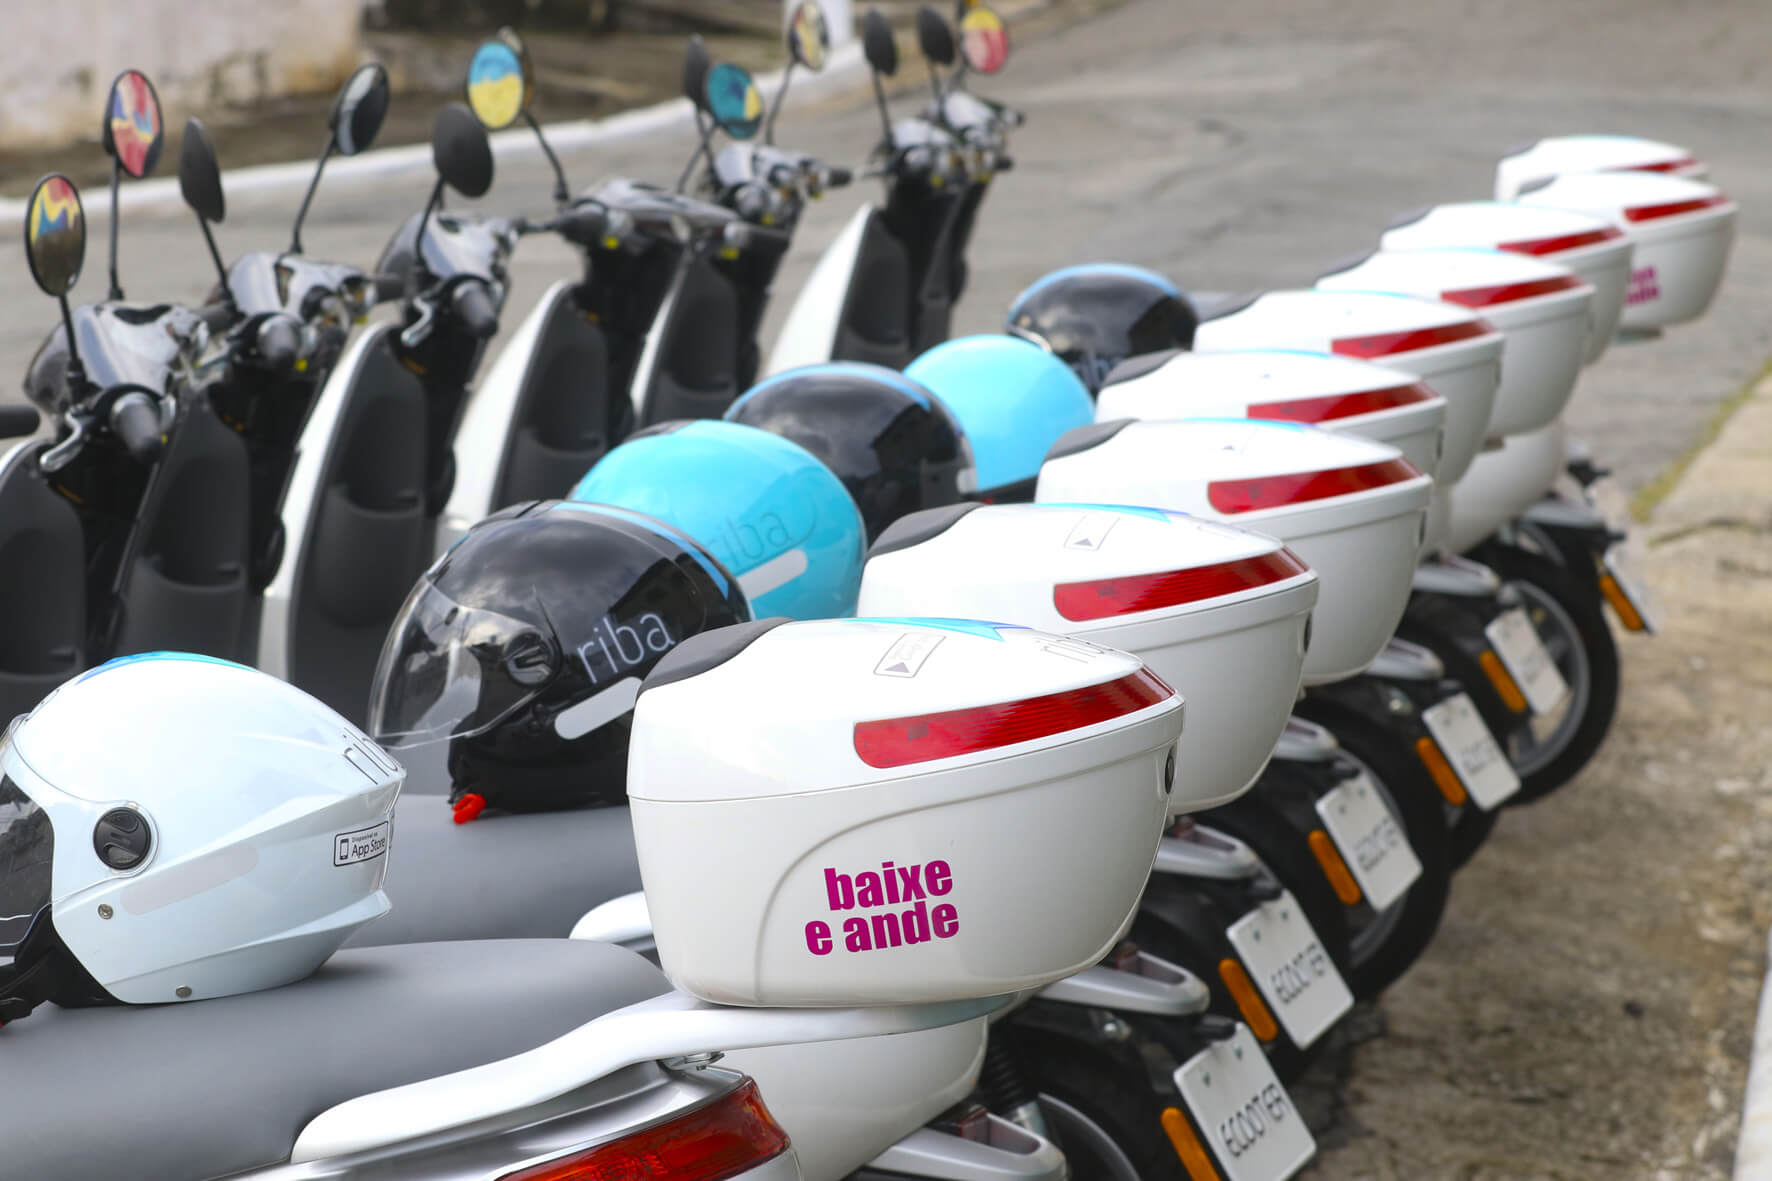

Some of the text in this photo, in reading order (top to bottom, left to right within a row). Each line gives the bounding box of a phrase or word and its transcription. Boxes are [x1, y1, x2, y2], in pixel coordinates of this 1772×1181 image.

[577, 612, 676, 684] riba
[1032, 636, 1106, 664] rib
[343, 726, 398, 785] rib
[352, 838, 386, 858] App Store
[824, 860, 952, 911] baixe
[805, 901, 959, 956] e ande
[1220, 1082, 1292, 1158] ECOOTER
